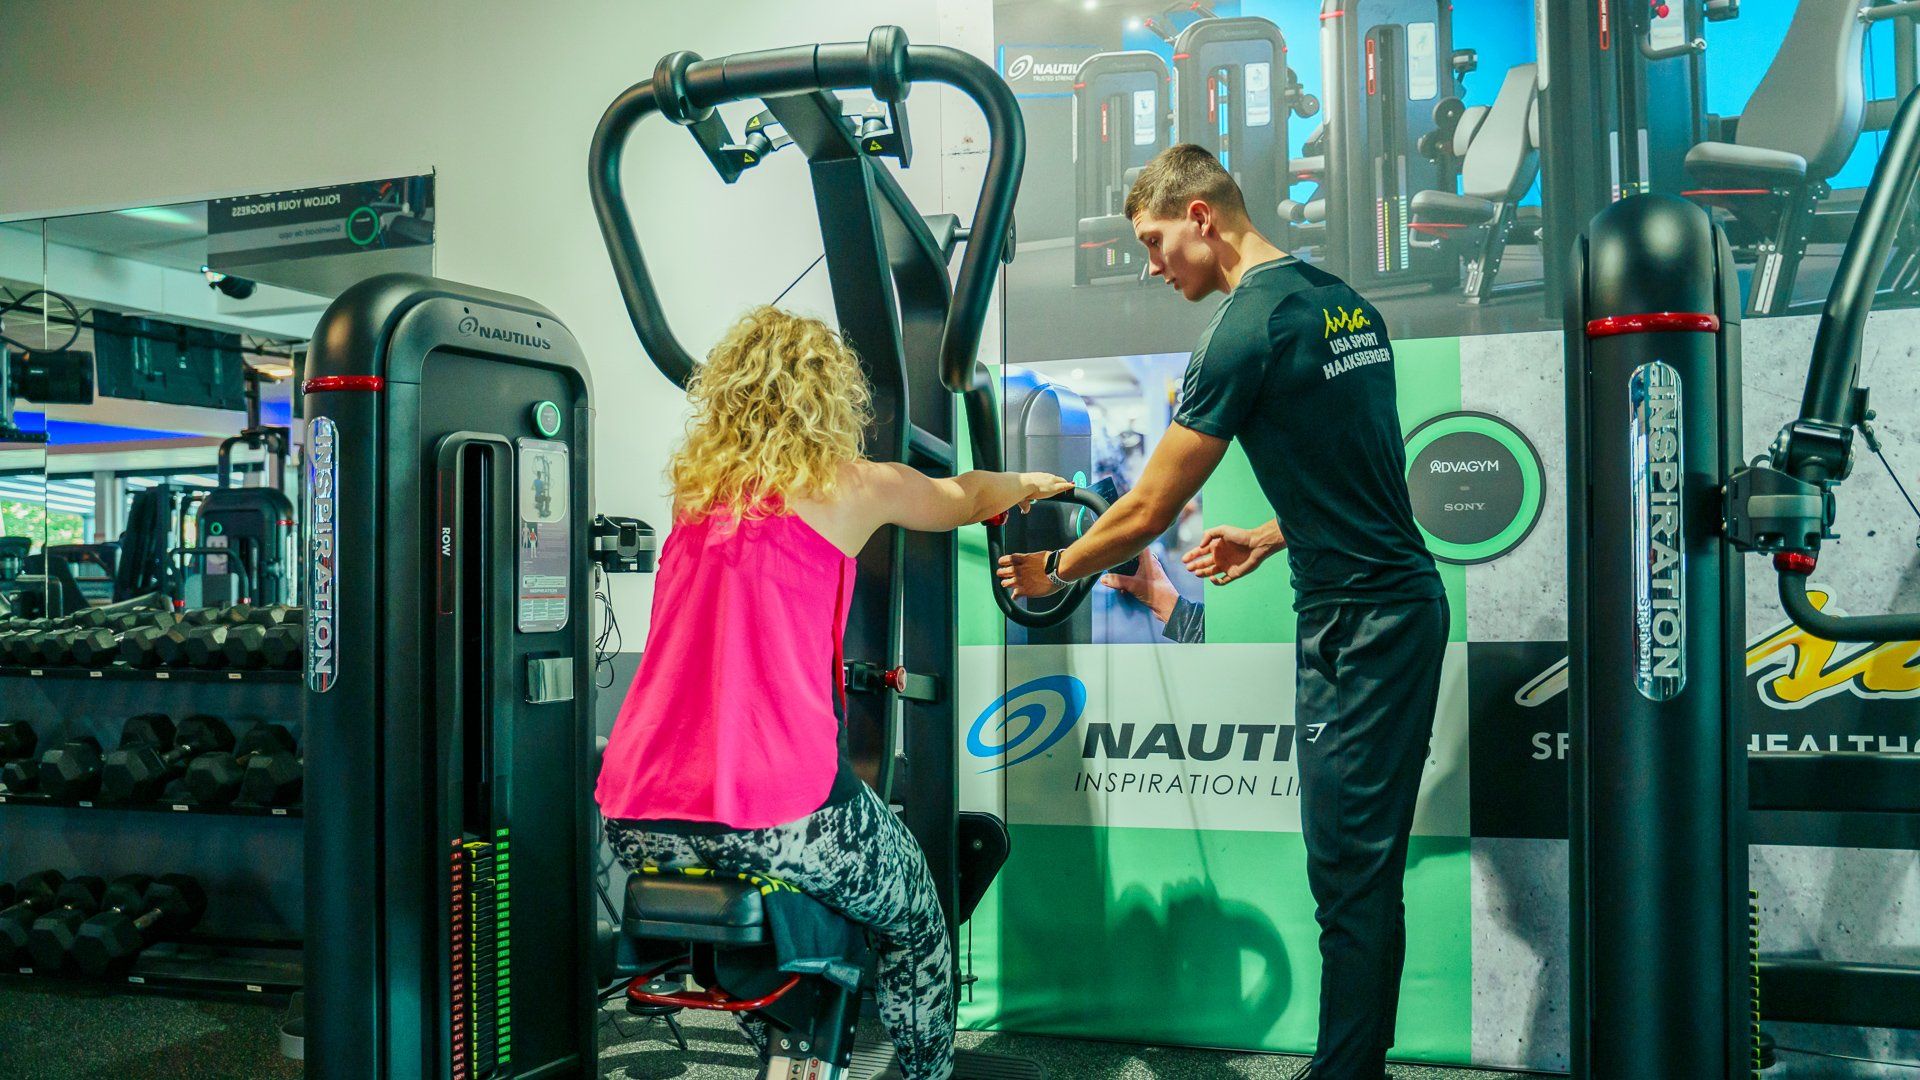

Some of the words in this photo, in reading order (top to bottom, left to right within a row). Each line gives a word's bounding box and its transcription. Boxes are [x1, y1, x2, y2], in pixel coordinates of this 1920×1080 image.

[1033, 63, 1081, 75] NAUTIL
[479, 326, 552, 350] NAUTILUS
[1329, 336, 1352, 355] USA
[1349, 332, 1379, 349] SPORT
[1322, 347, 1391, 380] HAAKSBERGEN
[1430, 459, 1499, 474] ADVAGYM
[1444, 502, 1486, 512] SONY
[442, 527, 451, 557] ROW
[1648, 386, 1680, 677] INSPIRATION
[314, 434, 333, 674] INSPIRATION
[1082, 723, 1296, 762] NAUTI
[1075, 772, 1257, 795] INSPIRATION
[1271, 776, 1300, 796] LI
[811, 1059, 819, 1068] 9
